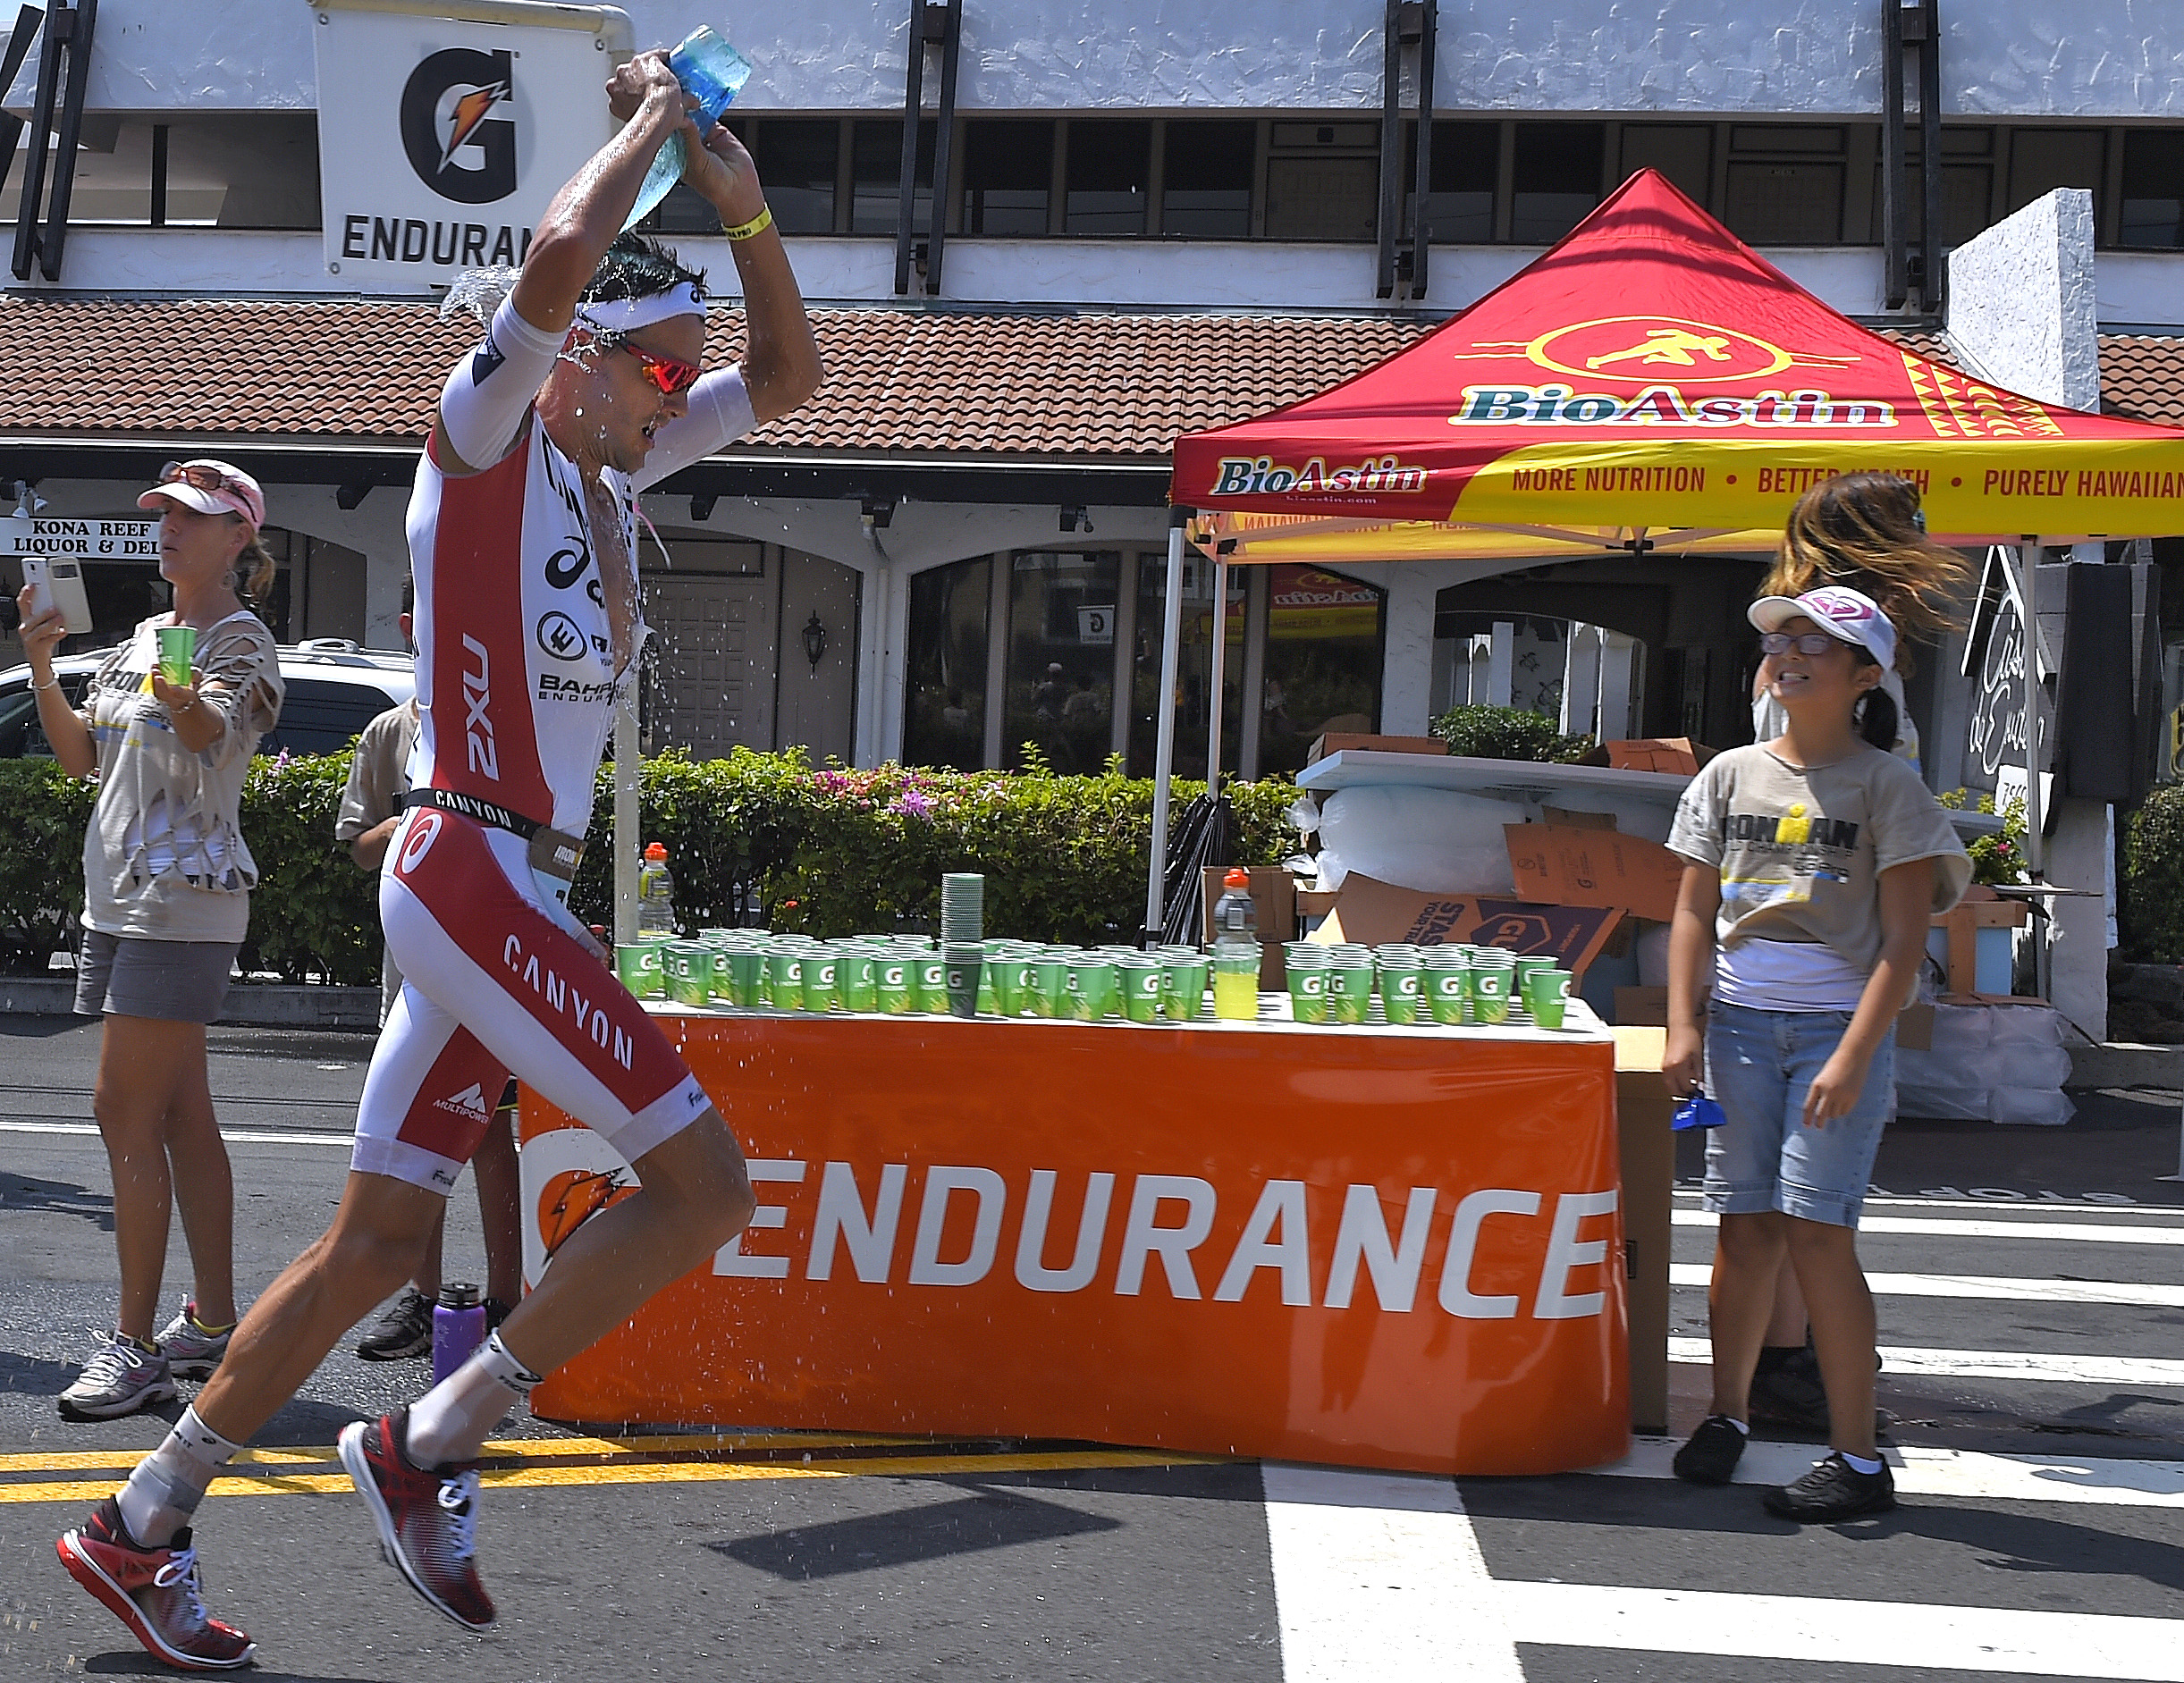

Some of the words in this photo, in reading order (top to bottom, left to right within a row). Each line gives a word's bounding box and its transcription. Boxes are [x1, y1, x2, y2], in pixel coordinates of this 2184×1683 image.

[400, 46, 518, 205] G
[1457, 385, 1896, 426] BioAstin
[1211, 457, 1427, 494] BioAstin
[1513, 467, 1576, 491] MORE
[1586, 467, 1706, 492] NUTRITION
[1984, 469, 2070, 496] PURELY
[33, 520, 90, 535] KONA
[99, 522, 151, 537] REEF
[13, 537, 89, 554] LIQUOR
[98, 539, 114, 554] &
[462, 632, 500, 781] 2XU
[435, 790, 512, 829] CANYON
[1302, 975, 1321, 994] G
[1398, 975, 1418, 995] G
[1440, 976, 1460, 995] G
[1479, 976, 1498, 995] G
[502, 933, 633, 1071] CANYON
[713, 1158, 1619, 1320] ENDURANCE
